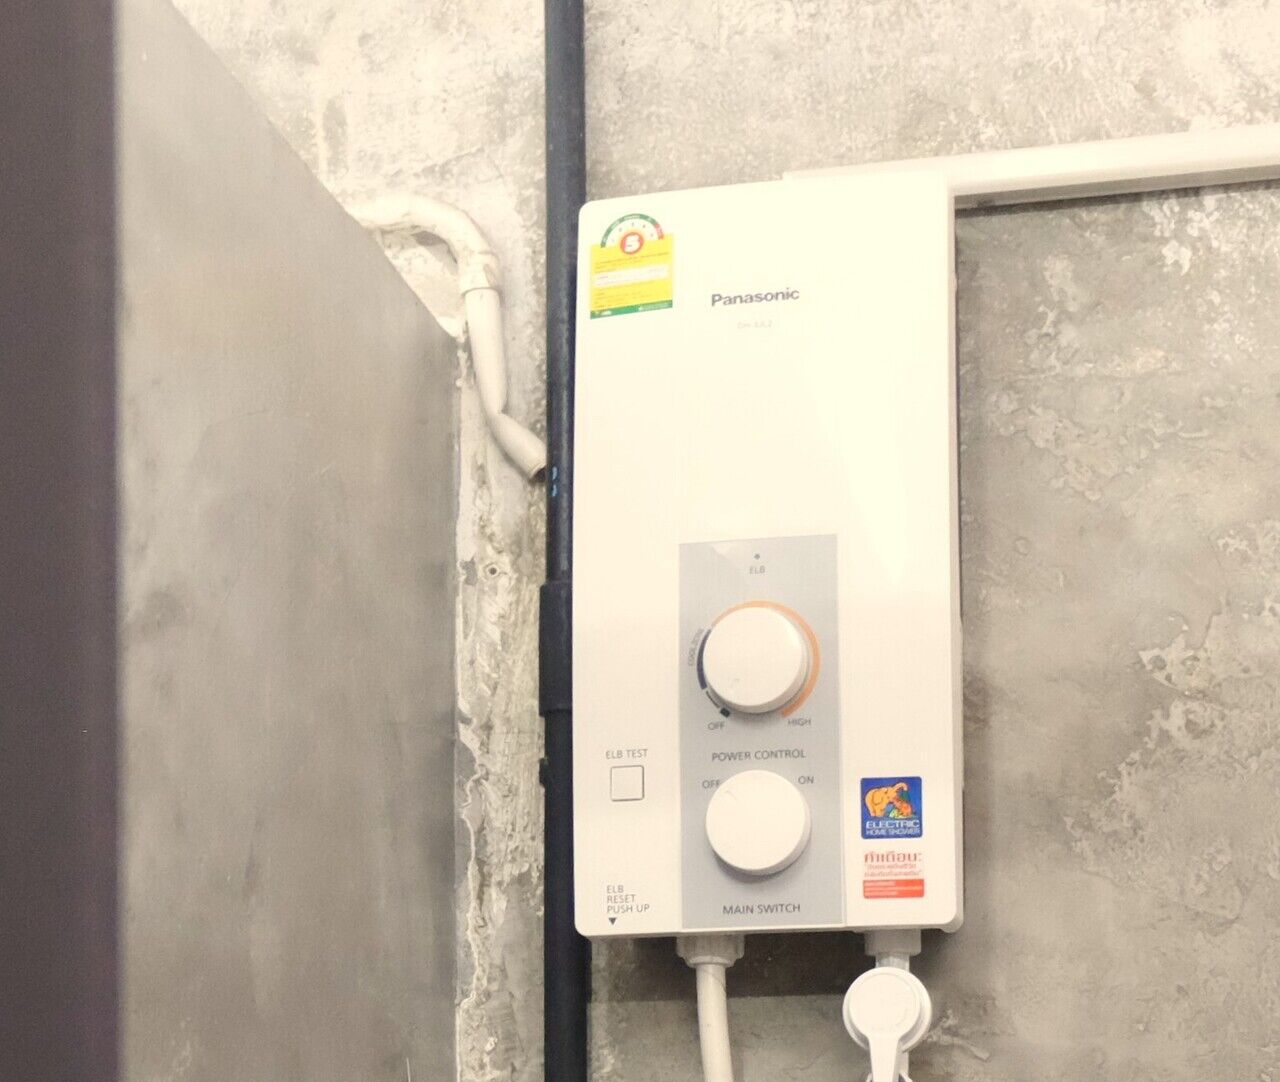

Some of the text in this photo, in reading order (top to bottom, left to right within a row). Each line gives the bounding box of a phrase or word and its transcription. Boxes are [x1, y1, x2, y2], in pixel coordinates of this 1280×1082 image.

[711, 287, 800, 307] Panasonic
[707, 720, 726, 731] OFF
[787, 717, 812, 726] HIGH
[605, 748, 648, 760] ELB TEST
[711, 748, 807, 762] POWER CONTROL
[702, 779, 721, 789] OFF
[797, 775, 815, 785] ON
[865, 820, 920, 829] ELECTRIC
[606, 884, 624, 894] ELB
[607, 894, 636, 904] RESET
[607, 903, 650, 914] PUSH UP
[722, 903, 801, 914] MAIN SWITCH
